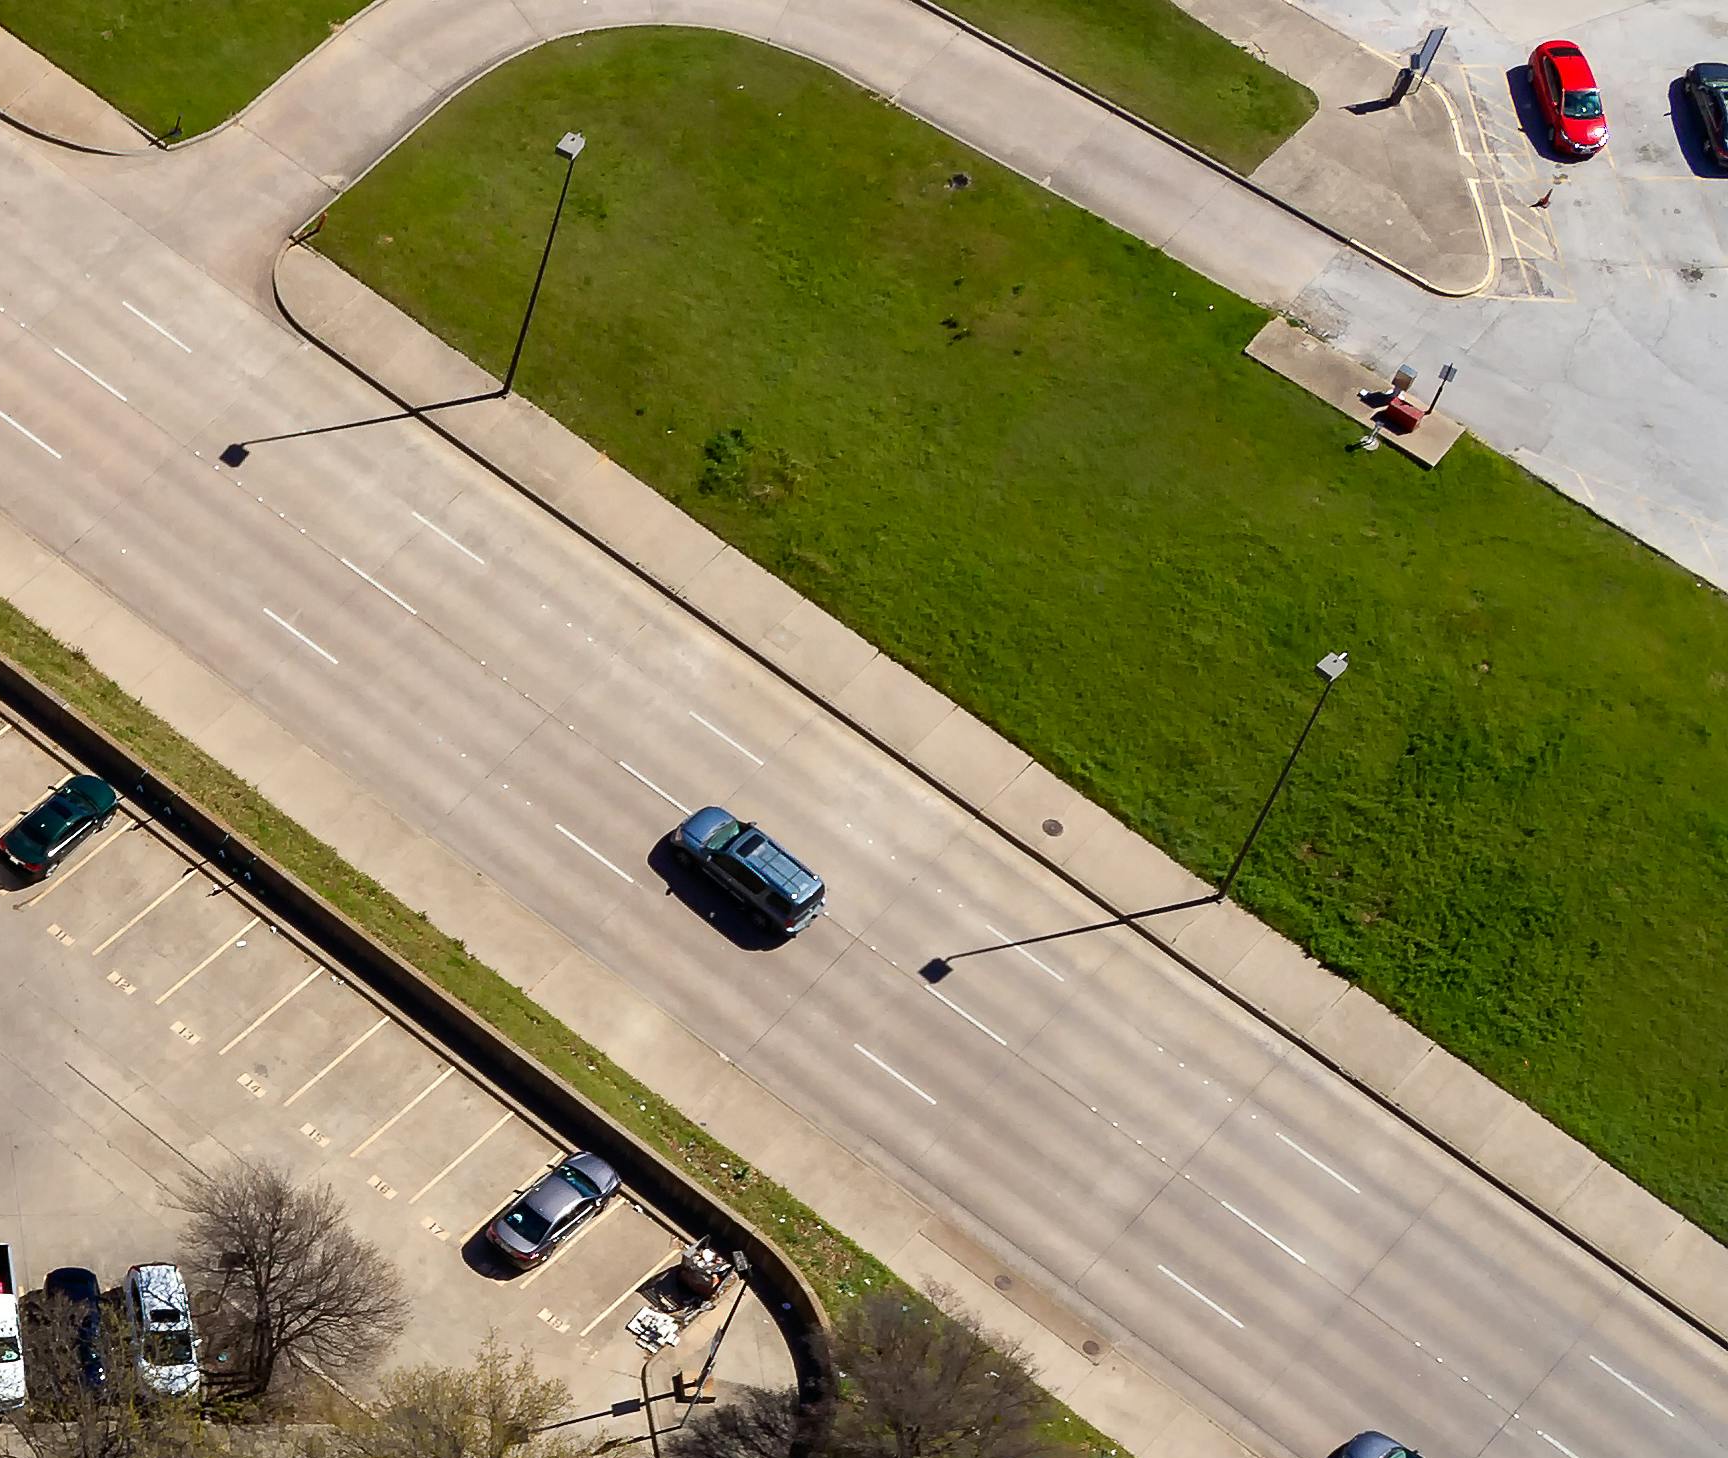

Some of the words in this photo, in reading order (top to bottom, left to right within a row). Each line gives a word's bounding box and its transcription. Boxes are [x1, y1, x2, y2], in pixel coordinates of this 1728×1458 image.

[55, 930, 66, 940] 11
[115, 977, 130, 990] 12
[179, 1027, 194, 1040] 13
[245, 1080, 261, 1093] 14
[309, 1129, 325, 1142] 15
[429, 1222, 444, 1234] 17
